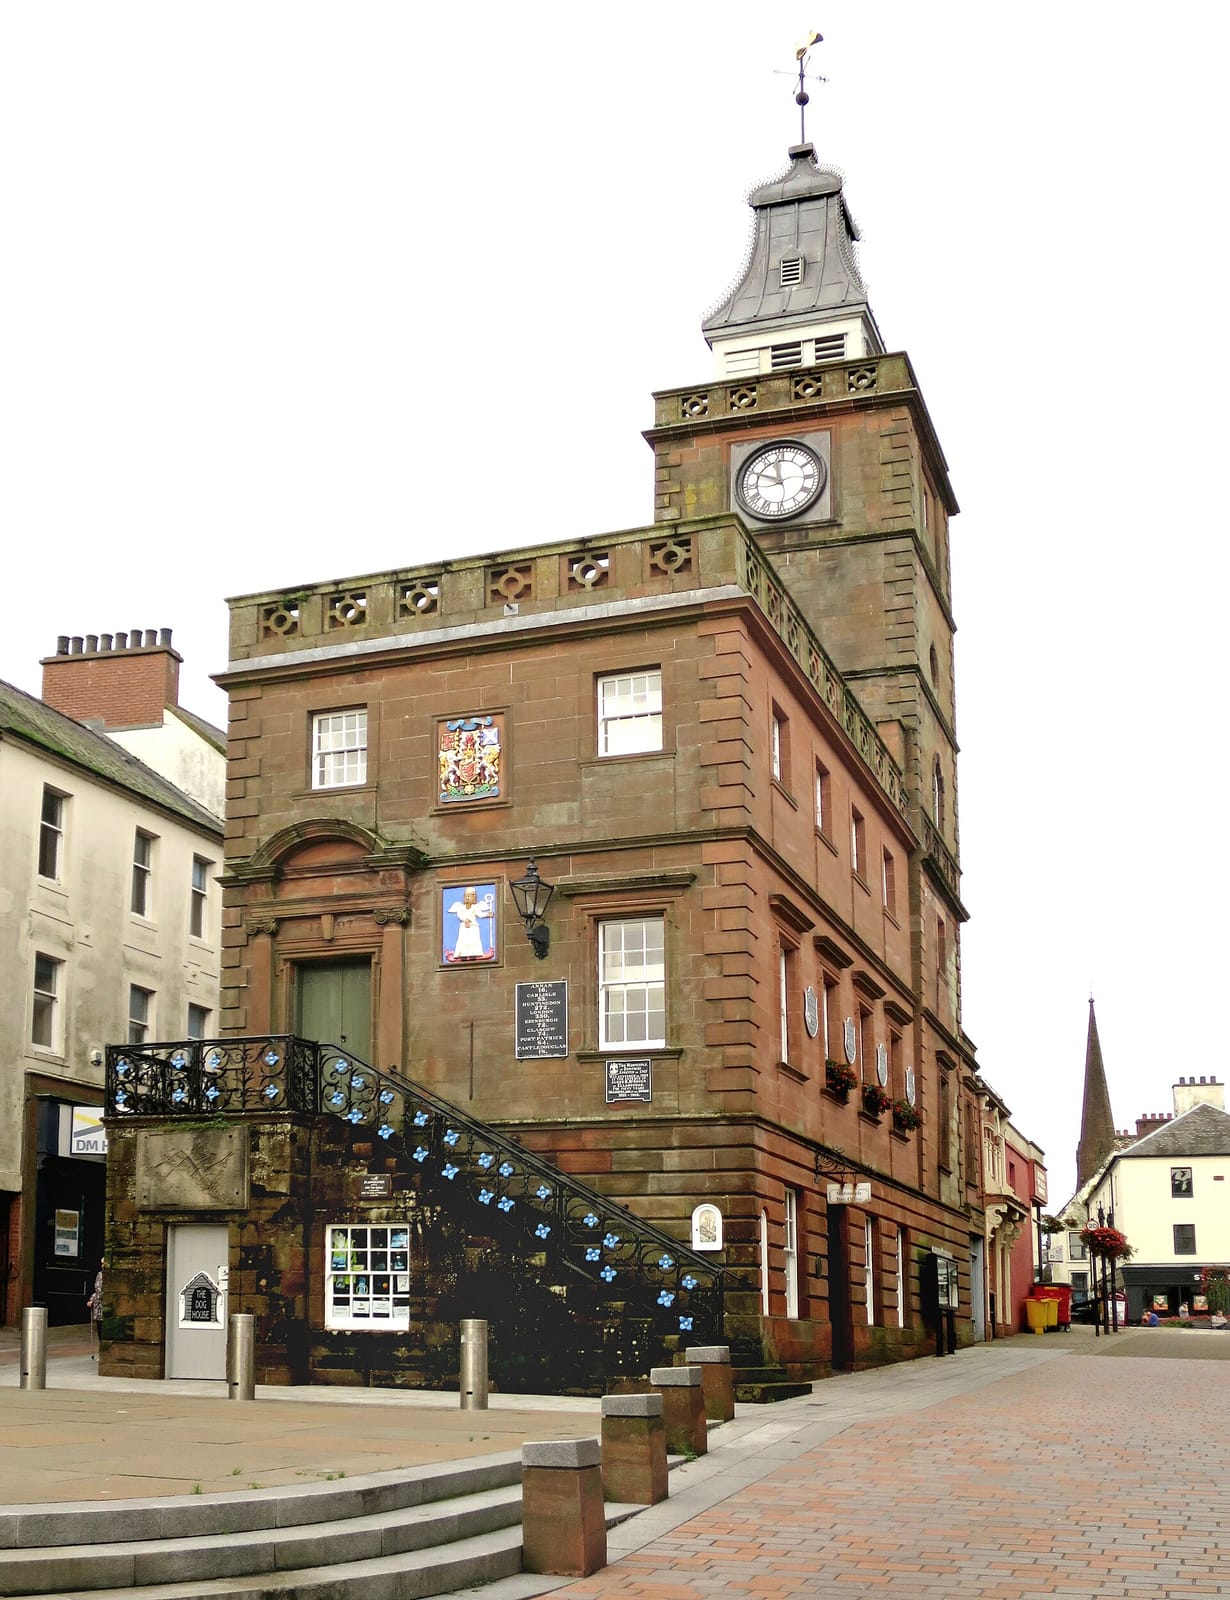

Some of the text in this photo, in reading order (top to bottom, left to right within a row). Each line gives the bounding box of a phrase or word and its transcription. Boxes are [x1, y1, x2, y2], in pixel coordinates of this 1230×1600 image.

[76, 1140, 98, 1152] DM
[195, 1300, 207, 1310] DOG
[191, 1310, 210, 1320] HOUSE
